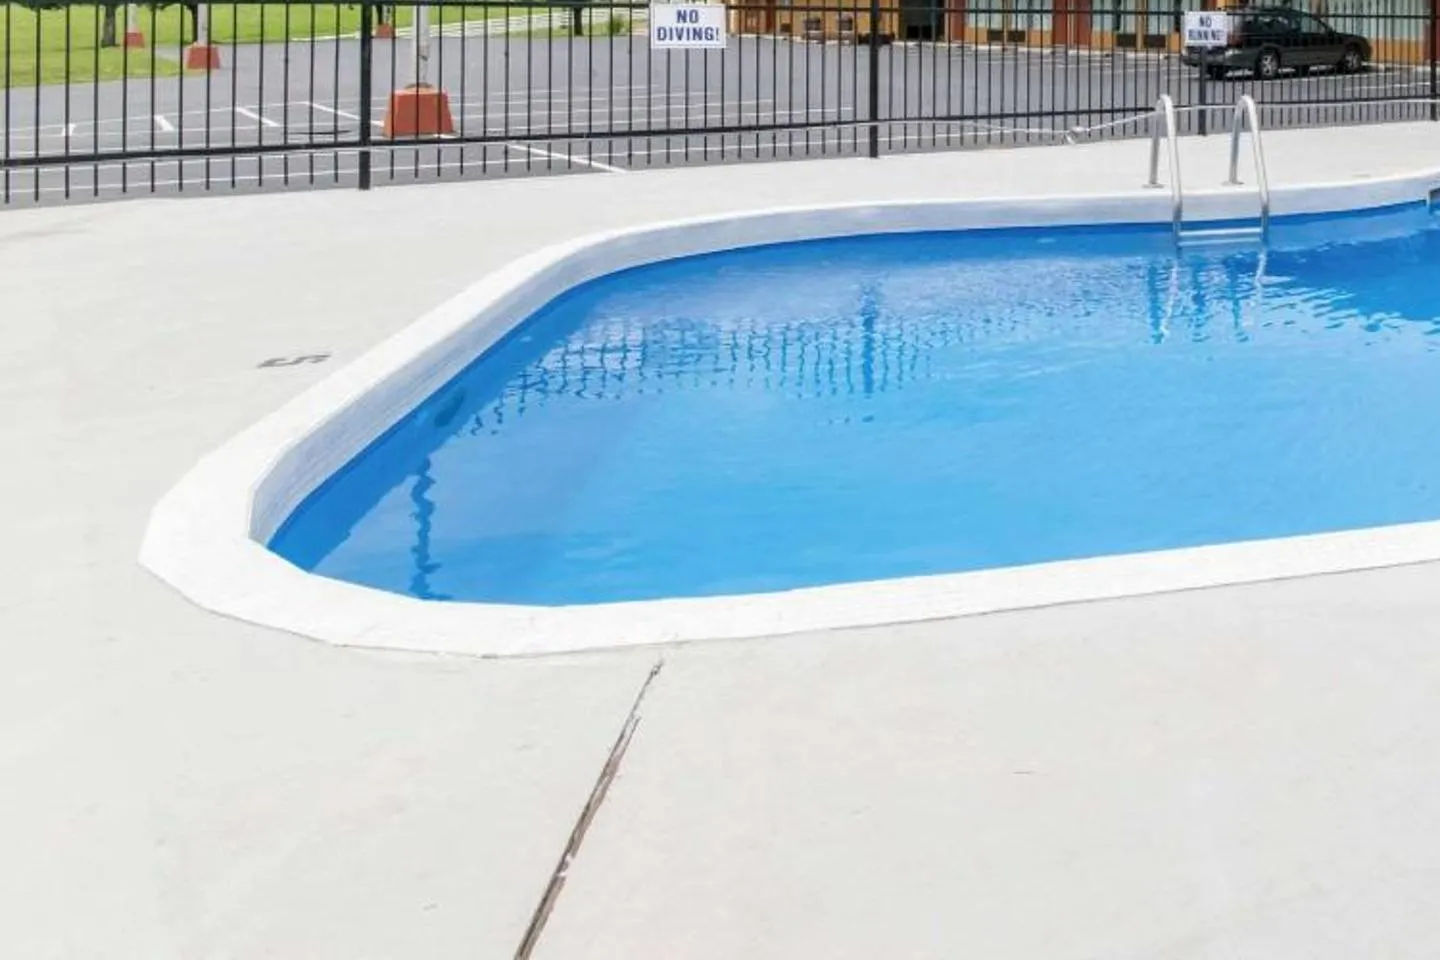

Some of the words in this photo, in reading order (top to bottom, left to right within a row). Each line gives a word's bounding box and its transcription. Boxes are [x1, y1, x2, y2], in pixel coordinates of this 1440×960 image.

[676, 9, 699, 24] NO
[1199, 16, 1212, 28] NO
[657, 26, 720, 41] DIVING!
